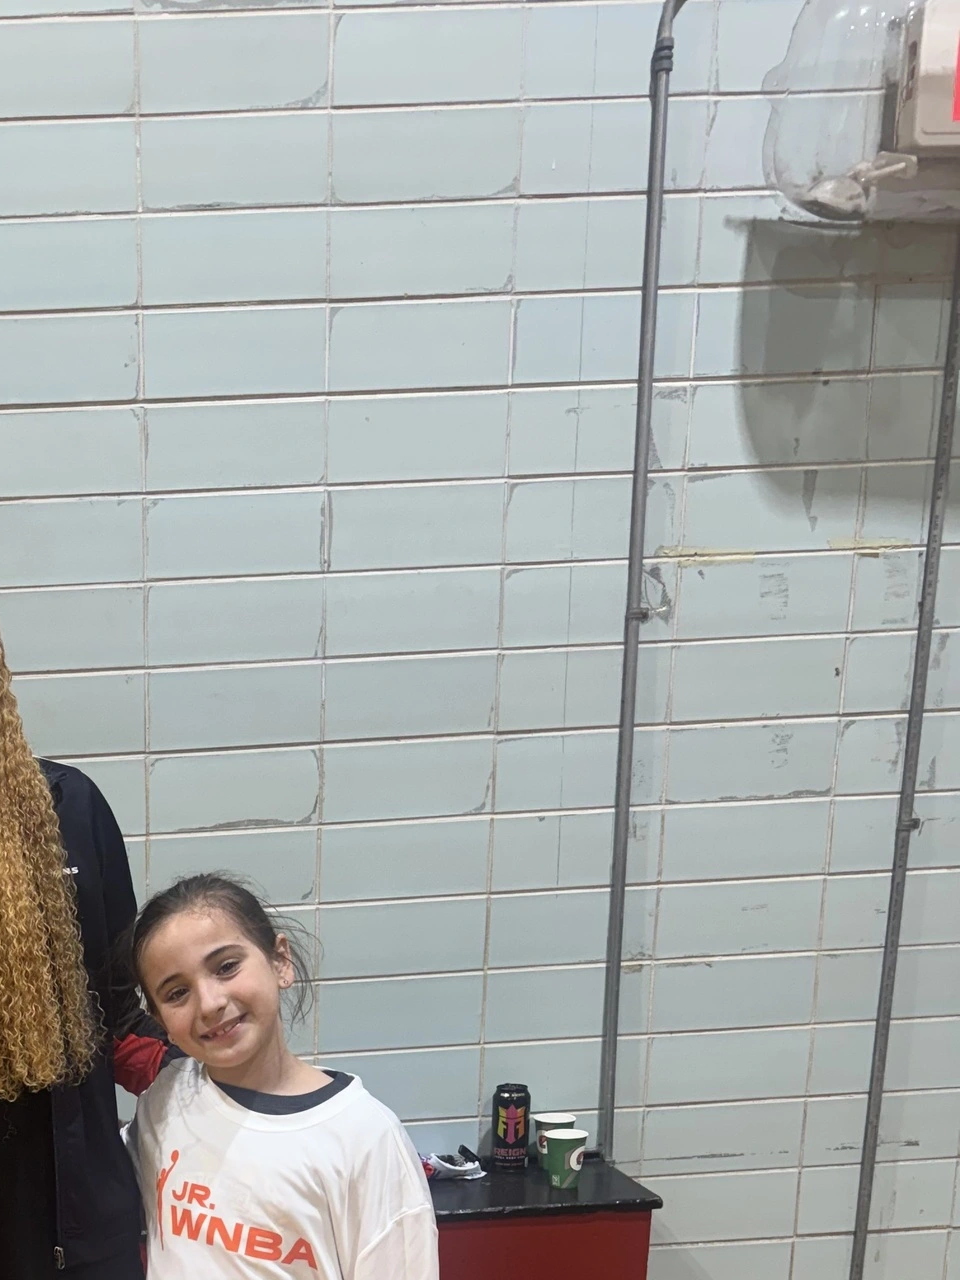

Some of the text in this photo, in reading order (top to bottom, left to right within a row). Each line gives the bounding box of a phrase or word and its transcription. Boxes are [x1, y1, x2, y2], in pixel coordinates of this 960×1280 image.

[493, 1147, 527, 1157] REIGN
[172, 1181, 215, 1210] JR.
[171, 1204, 318, 1271] WNBA
